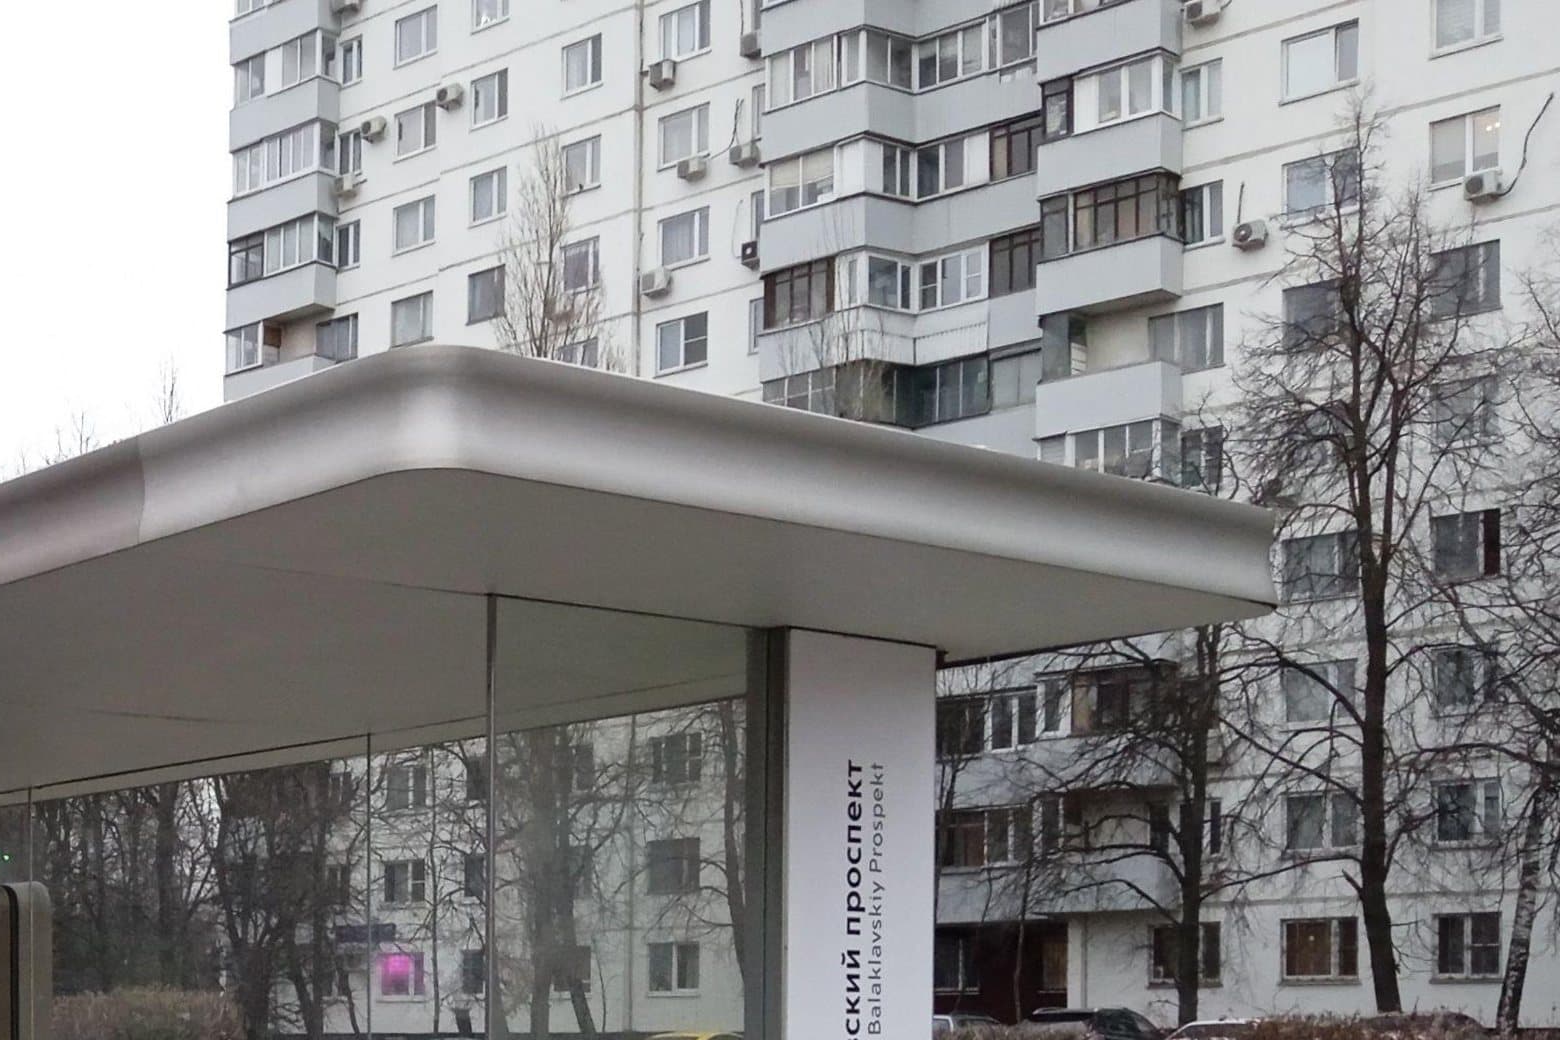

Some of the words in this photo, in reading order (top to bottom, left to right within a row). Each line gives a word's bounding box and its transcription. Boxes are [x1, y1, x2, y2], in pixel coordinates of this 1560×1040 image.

[846, 760, 865, 935] проспект
[869, 763, 886, 873] Prospekt
[868, 882, 885, 1035] Balaklavskiy
